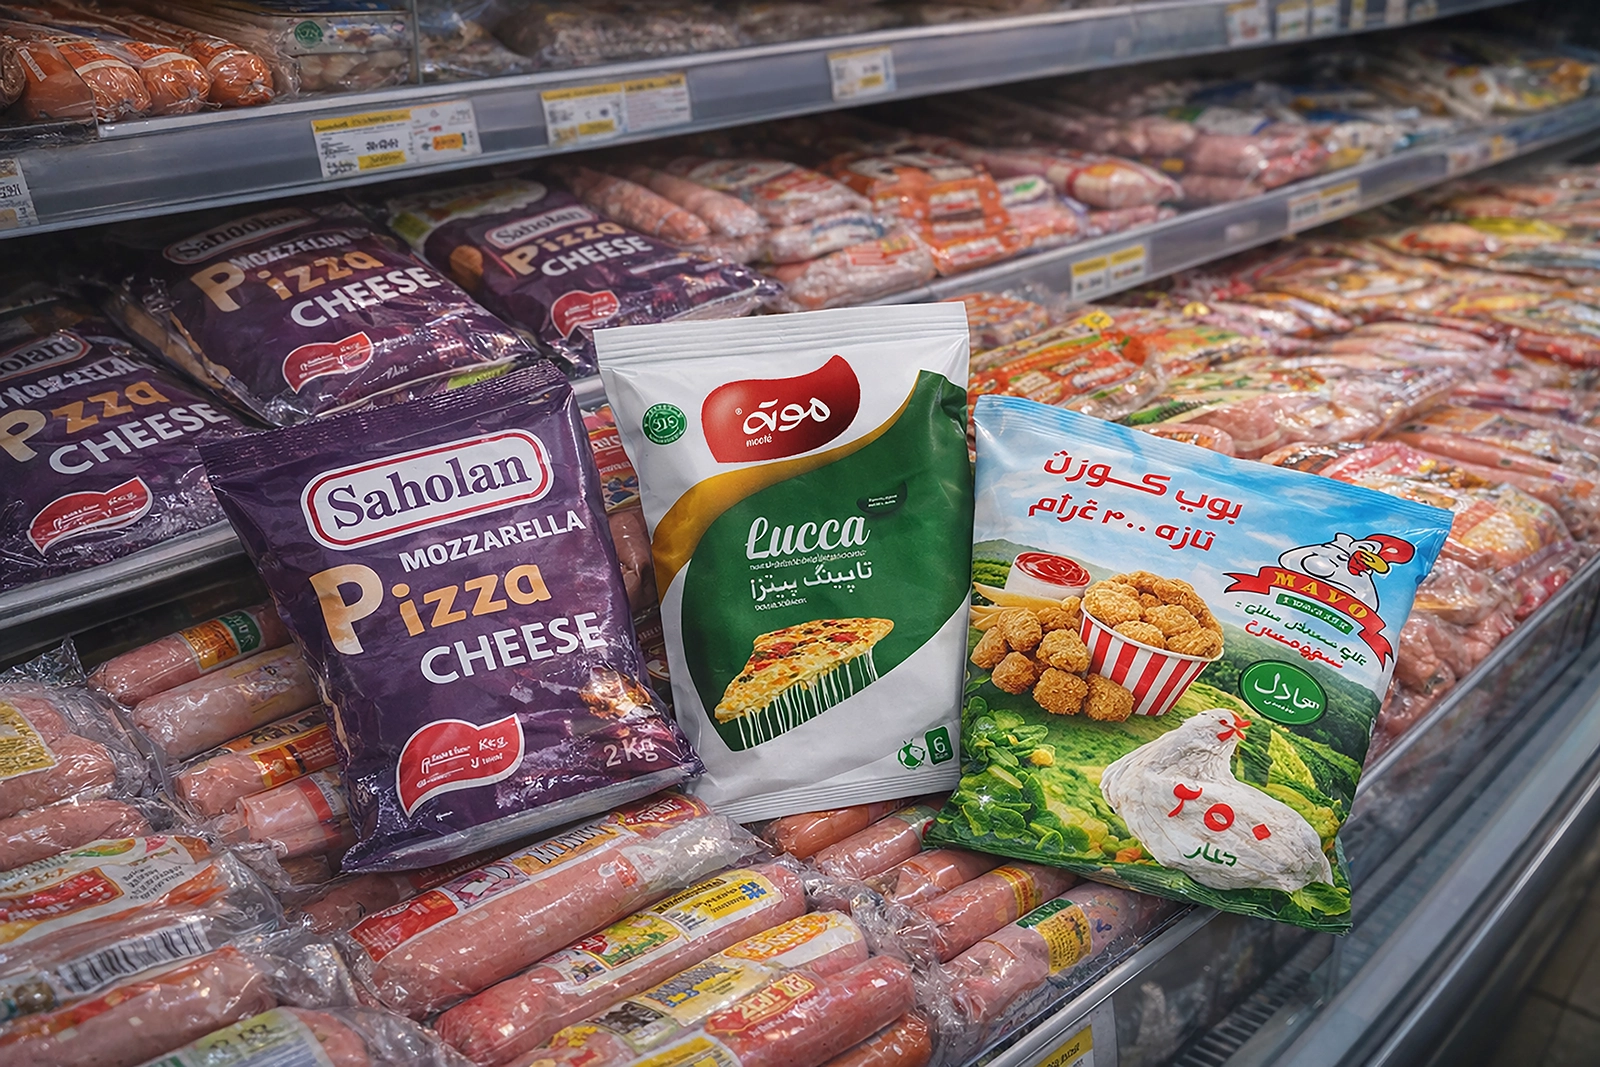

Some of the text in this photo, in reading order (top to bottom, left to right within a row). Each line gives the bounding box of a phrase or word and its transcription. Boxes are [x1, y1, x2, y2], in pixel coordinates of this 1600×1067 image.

[502, 222, 626, 275] Pizza
[541, 236, 653, 276] CHEESE
[191, 251, 385, 312] Pizza
[291, 267, 441, 327] CHEESE
[50, 403, 231, 474] CHEESE
[746, 434, 772, 447] mooté
[328, 457, 532, 530] Saholan
[399, 510, 586, 572] MOZZARELLA
[745, 516, 871, 560] Lucca
[309, 564, 552, 654] Pizza
[421, 612, 609, 684] CHEESE
[933, 736, 946, 753] 6
